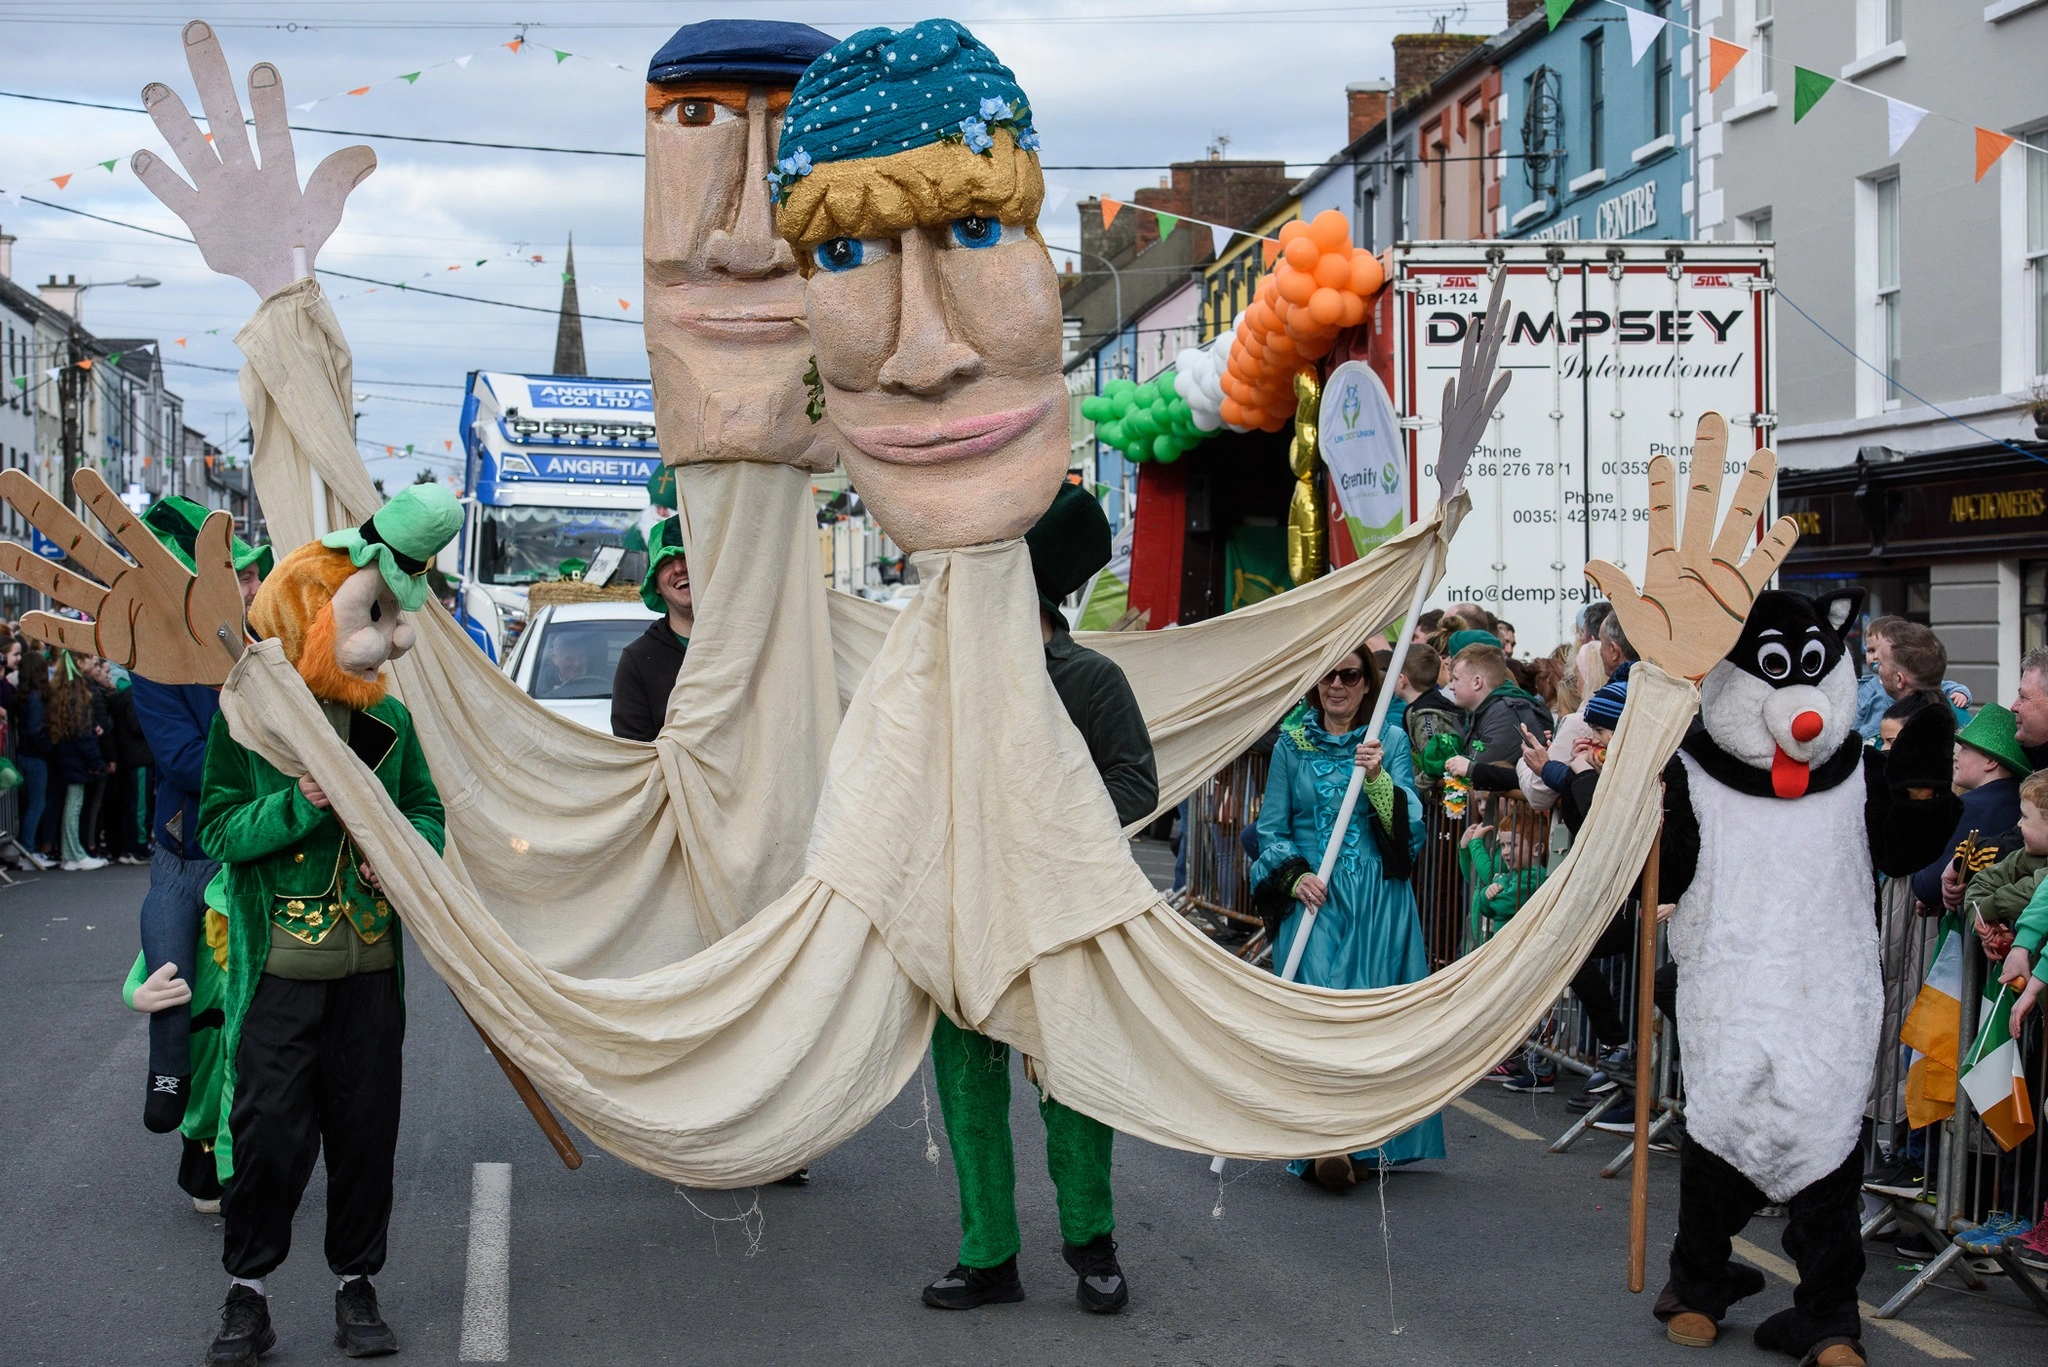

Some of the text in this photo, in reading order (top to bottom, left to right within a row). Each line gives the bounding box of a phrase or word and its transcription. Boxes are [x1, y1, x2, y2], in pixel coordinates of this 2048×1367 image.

[1596, 180, 1657, 240] CENTRE
[1416, 292, 1479, 306] DBI-124
[1558, 352, 1744, 380] International
[540, 386, 650, 400] ANGRETIA
[559, 395, 631, 408] CO. LTD
[1471, 444, 1522, 458] Phone
[546, 457, 652, 477] ANGRETIA
[1478, 463, 1497, 477] 86
[1502, 463, 1531, 477] 276
[1564, 491, 1614, 504] Phone
[1590, 508, 1627, 522] 9742
